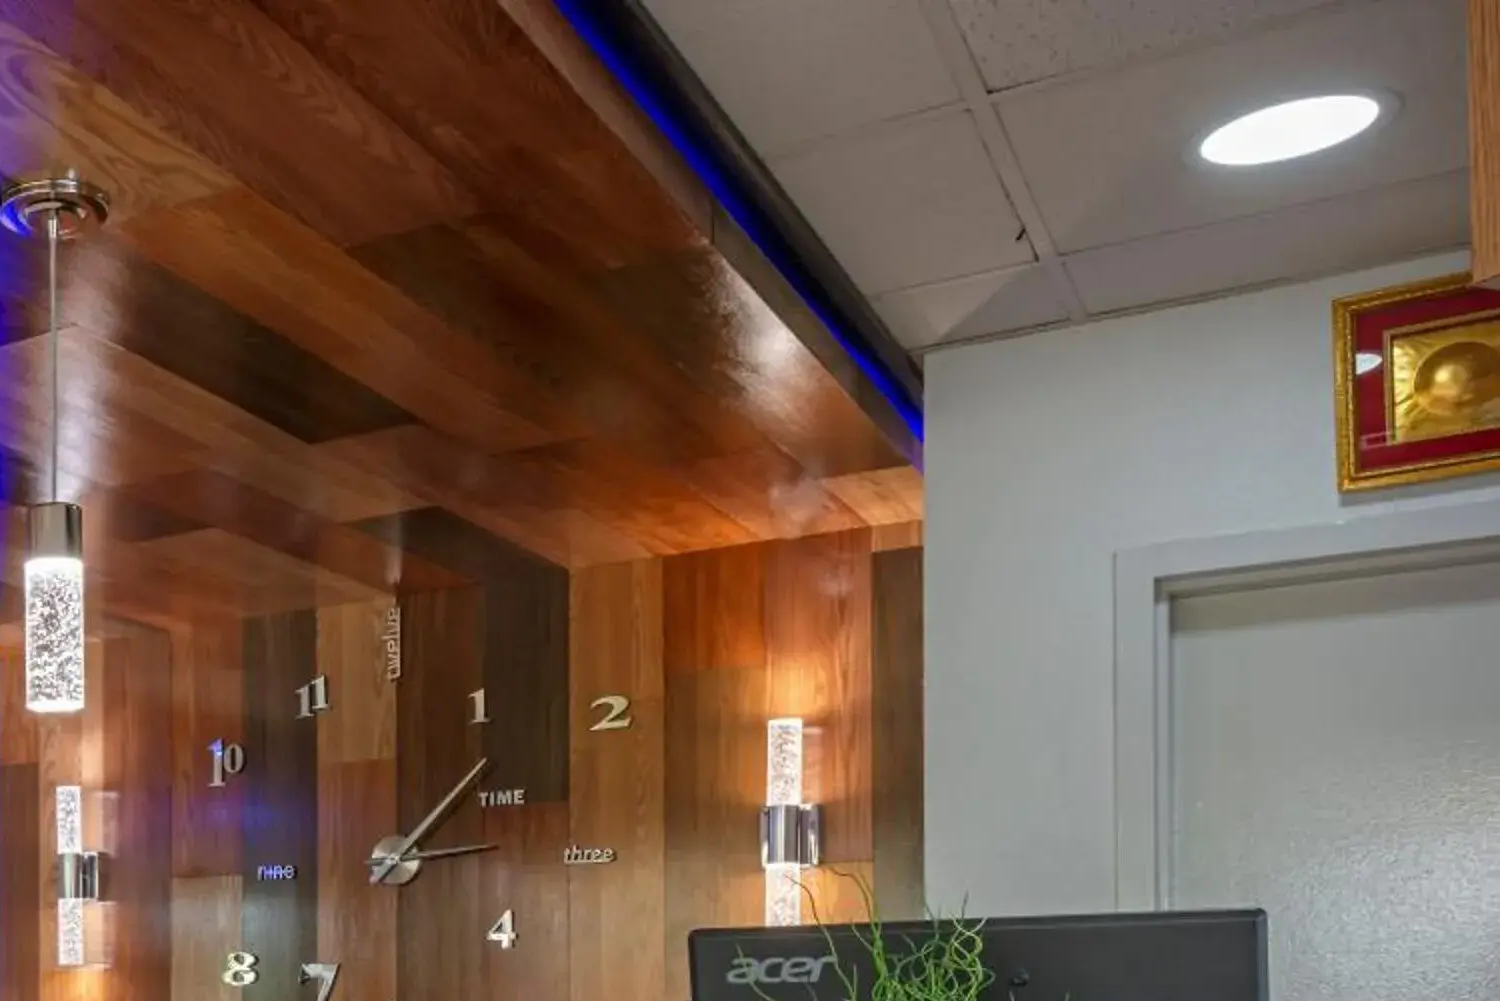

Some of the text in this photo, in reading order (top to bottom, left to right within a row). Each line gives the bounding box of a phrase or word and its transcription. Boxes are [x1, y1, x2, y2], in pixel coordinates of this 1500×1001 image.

[294, 675, 329, 720] 11
[467, 687, 491, 724] 1
[588, 695, 632, 731] 2
[206, 738, 245, 787] 10
[478, 789, 525, 807] TIME
[563, 845, 616, 864] three
[486, 909, 518, 949] 4
[222, 952, 258, 987] 8
[726, 956, 838, 983] acer
